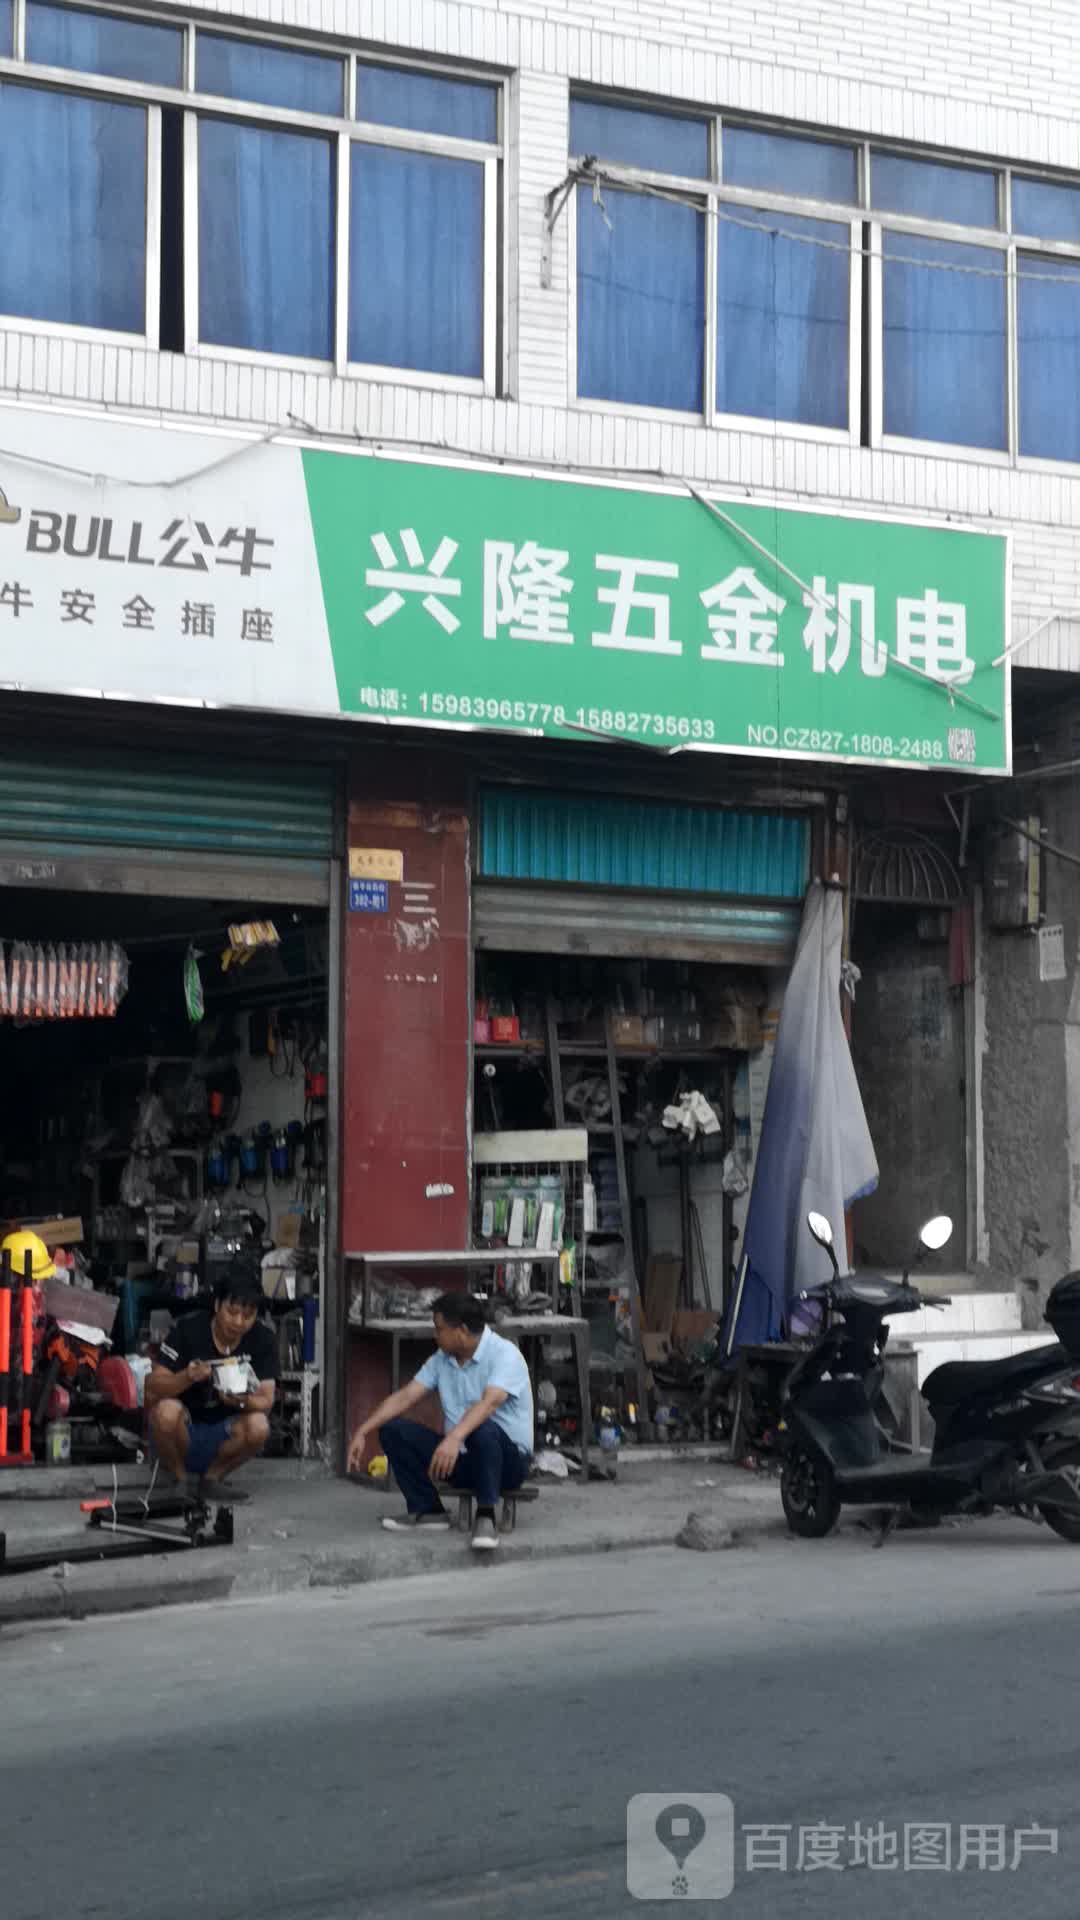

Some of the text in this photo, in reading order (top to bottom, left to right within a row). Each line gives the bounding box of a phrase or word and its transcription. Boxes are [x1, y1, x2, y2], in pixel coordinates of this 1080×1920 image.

[0, 581, 274, 643] 牛安全插座
[364, 528, 976, 685] 兴隆五金机电
[419, 692, 565, 725] 15983965778
[576, 707, 715, 739] 15882735633
